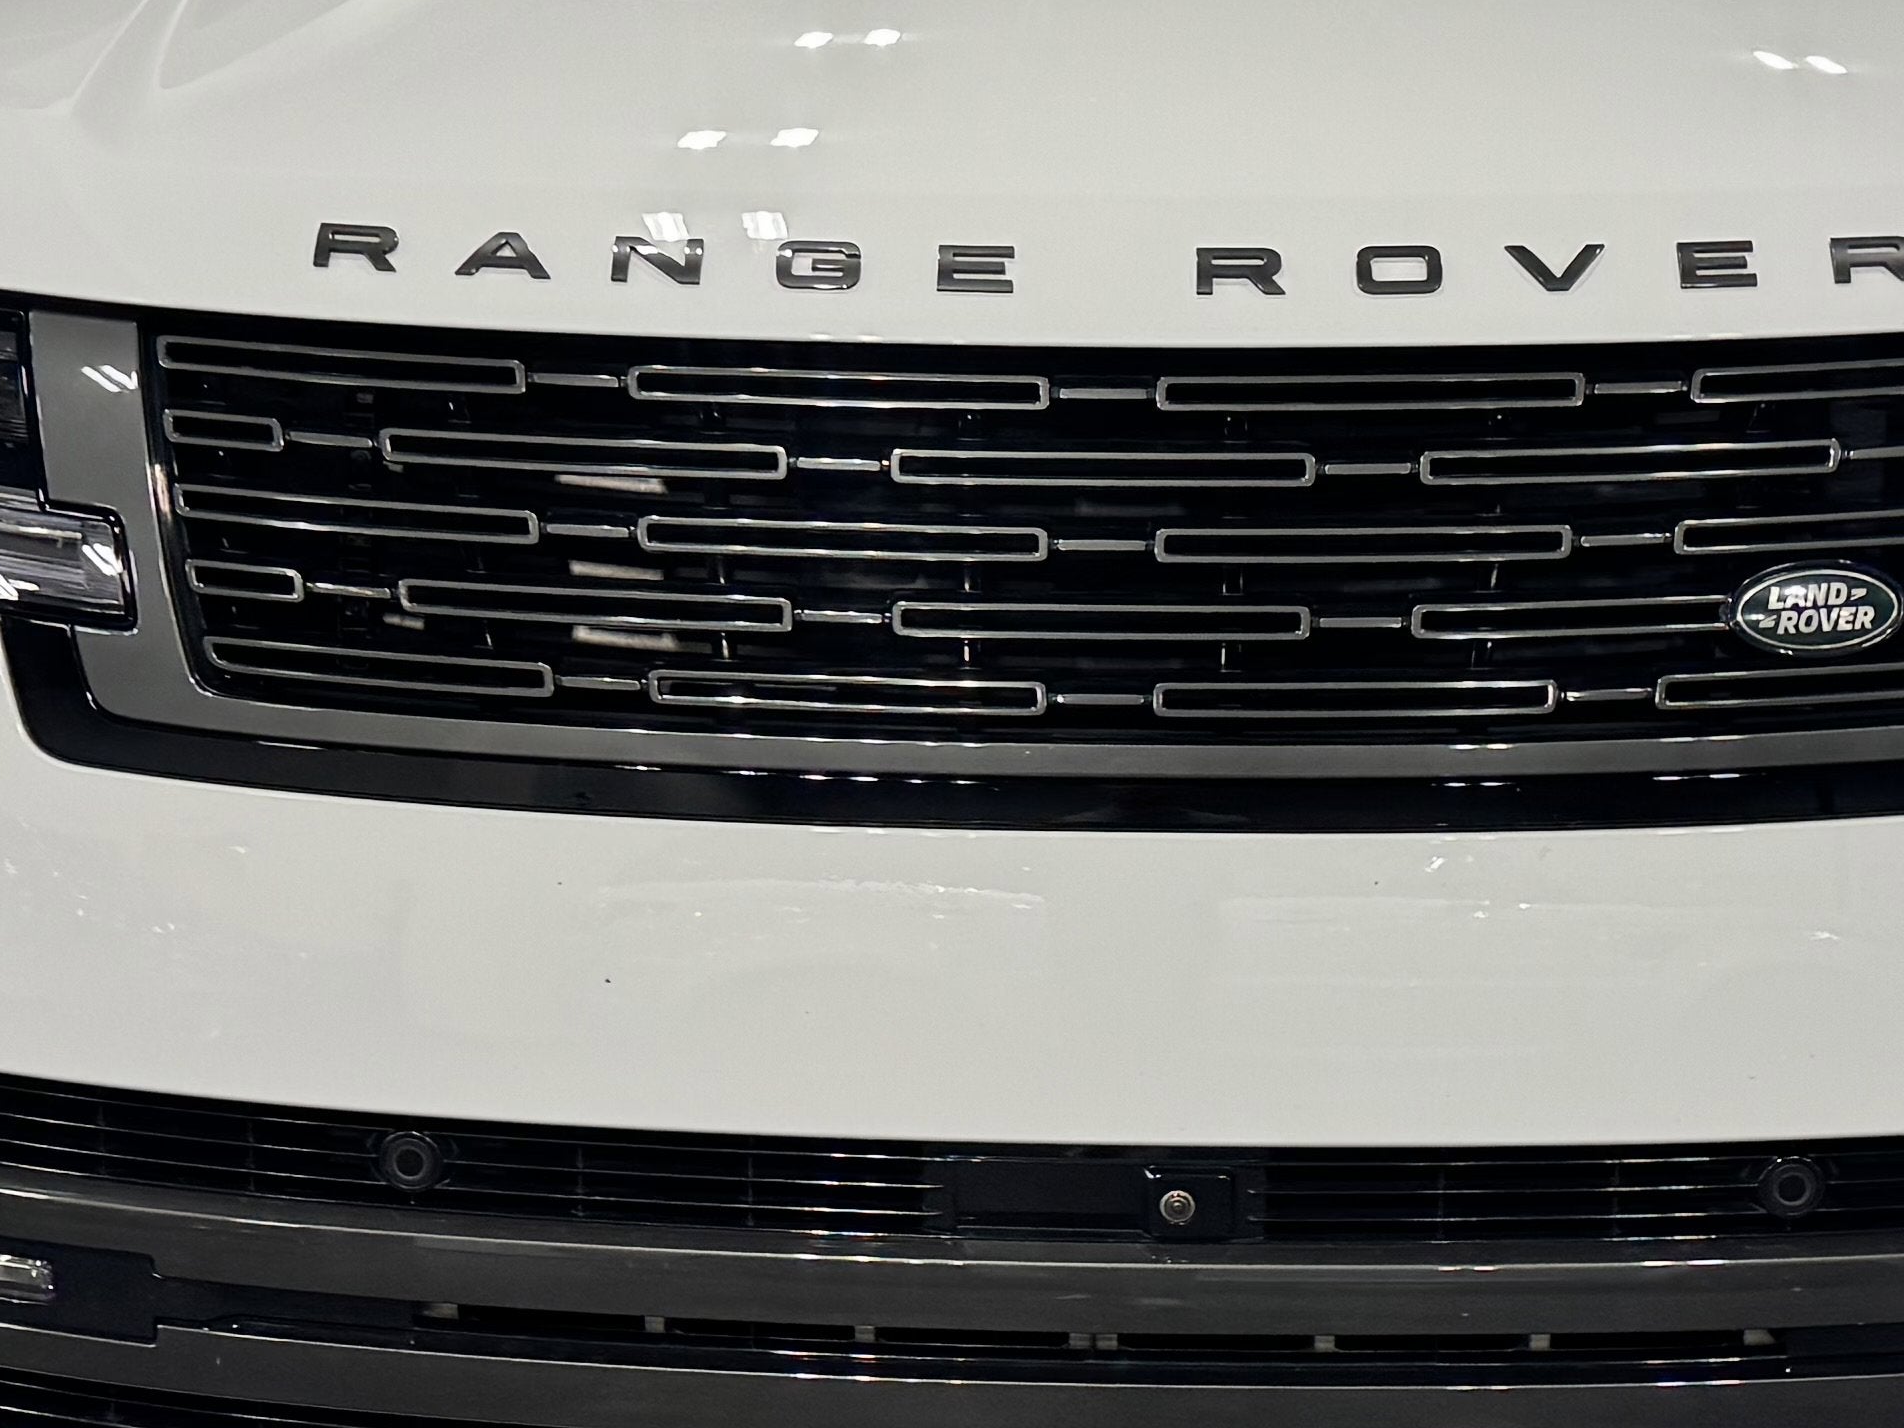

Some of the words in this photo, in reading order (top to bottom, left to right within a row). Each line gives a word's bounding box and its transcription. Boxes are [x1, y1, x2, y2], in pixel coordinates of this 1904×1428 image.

[313, 221, 1016, 293] RANGE
[1767, 582, 1848, 610] LAND
[1776, 605, 1876, 635] ROVER
